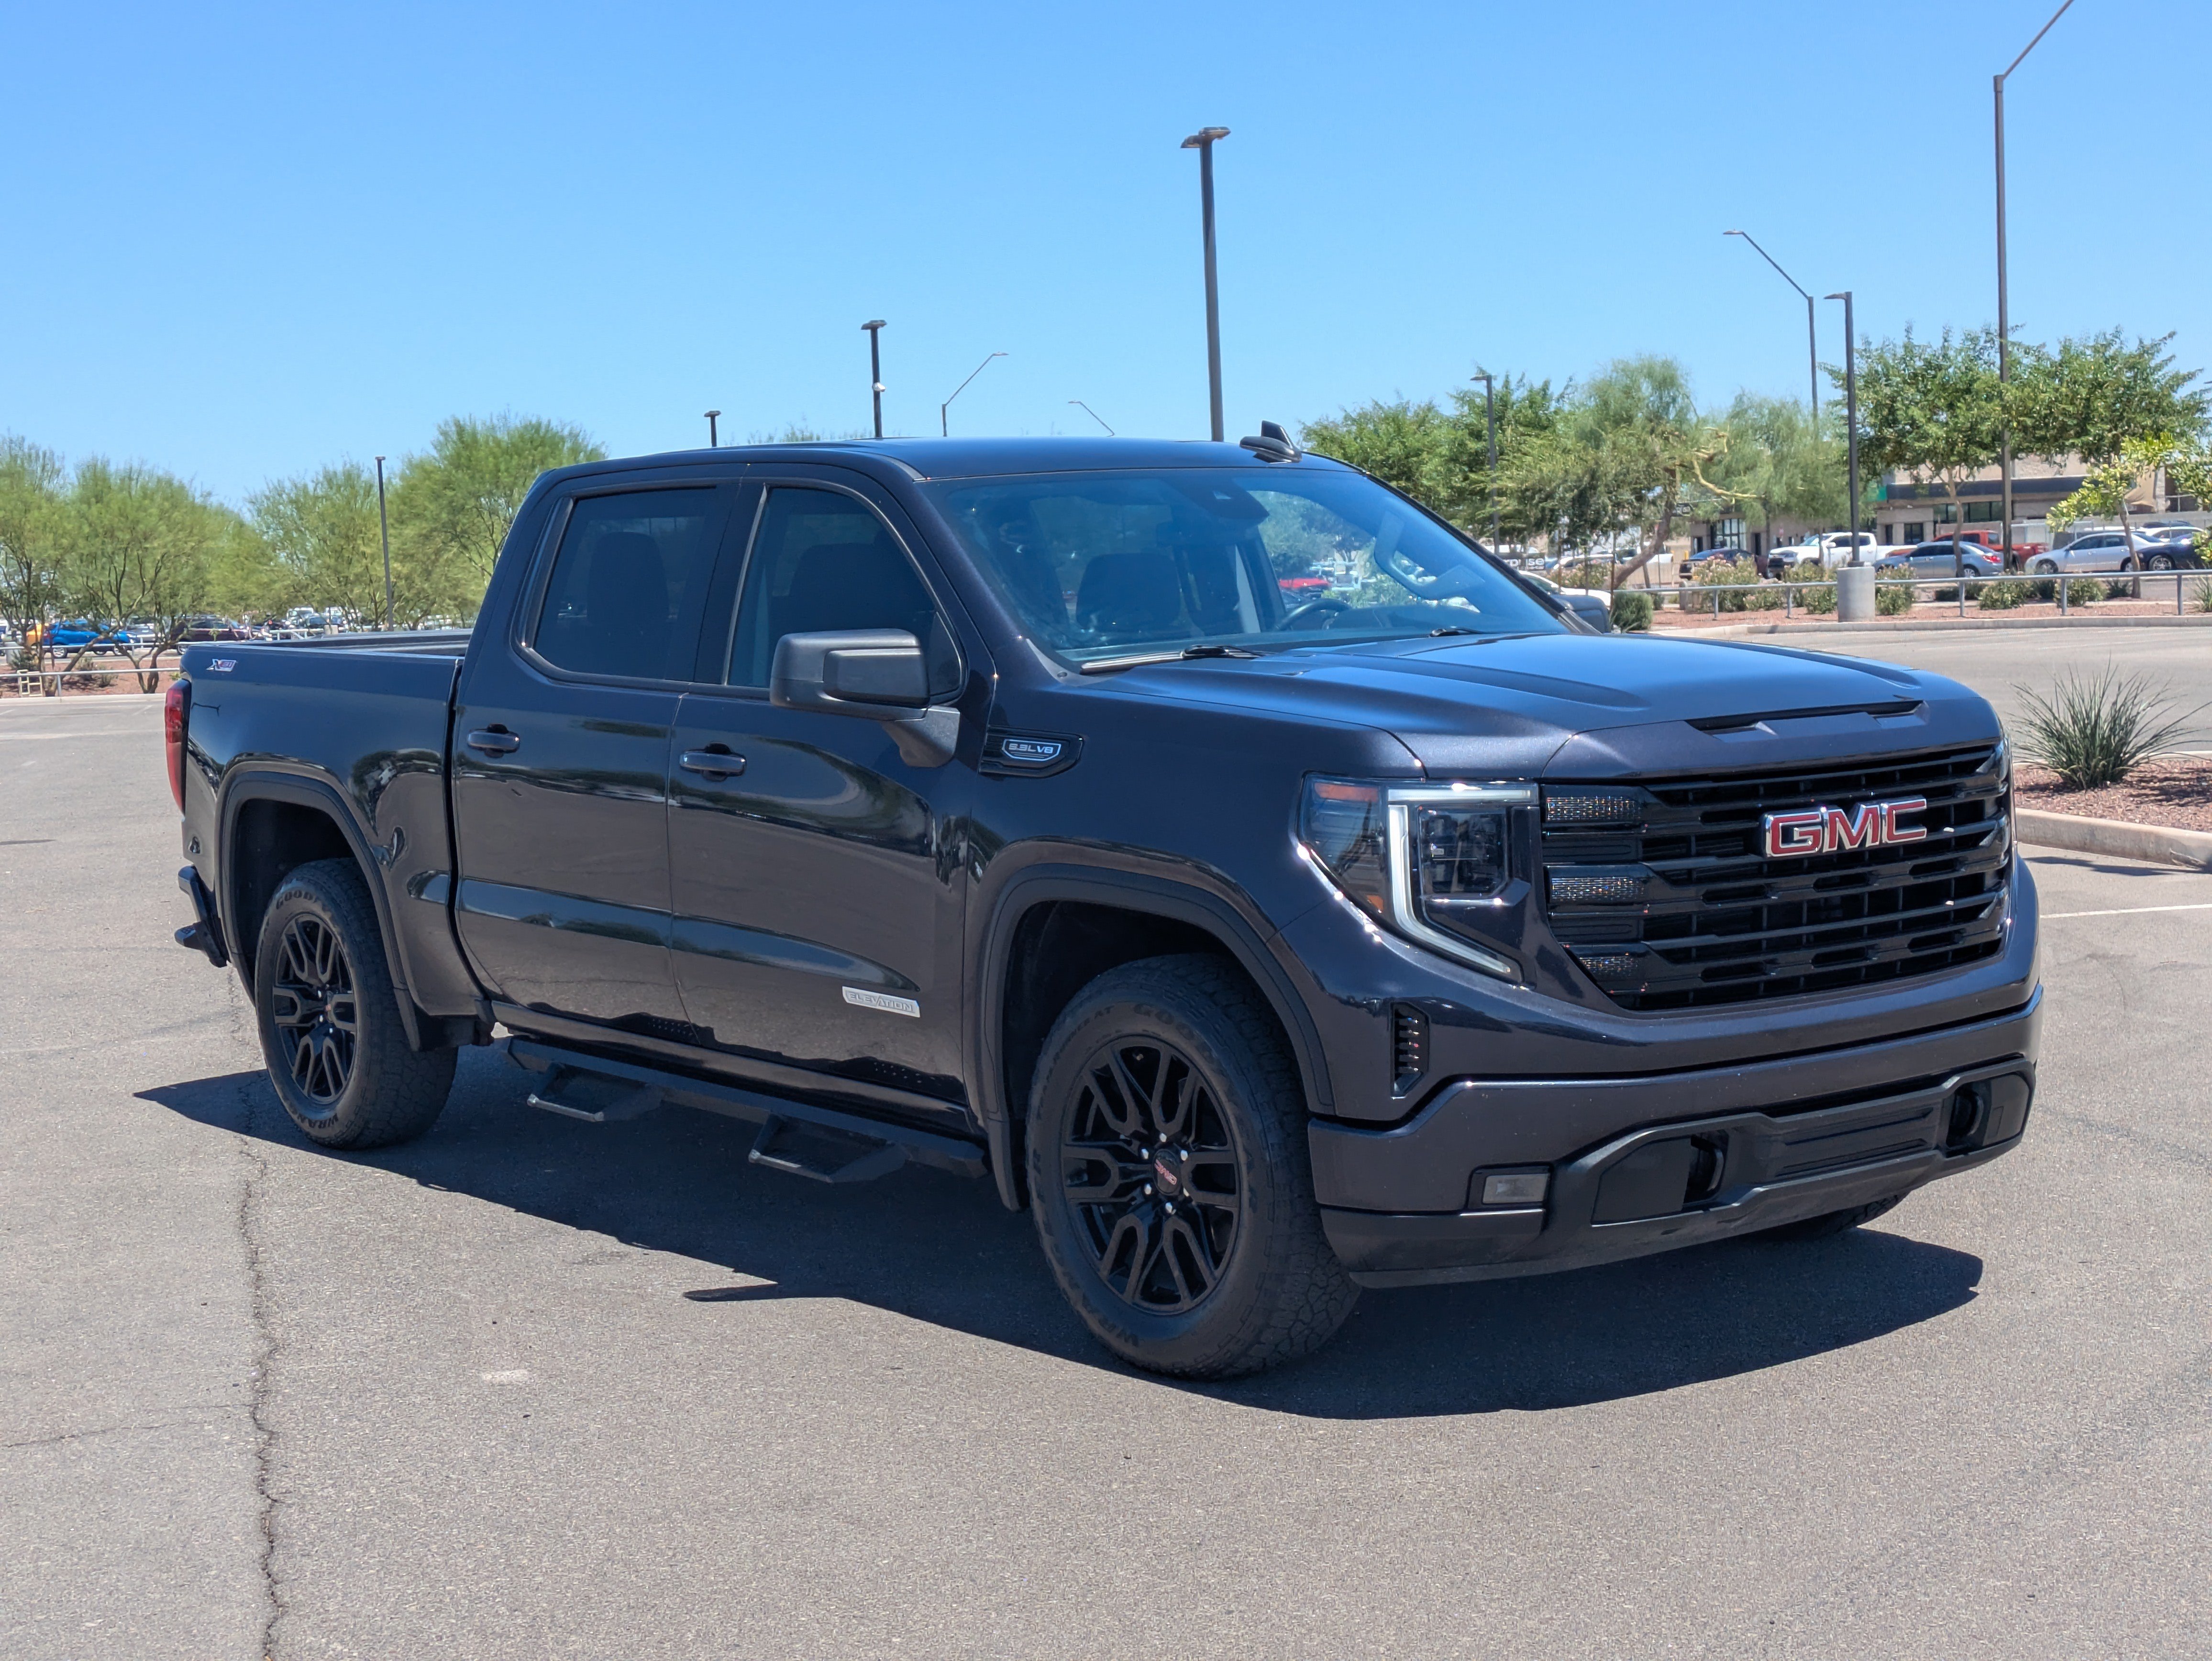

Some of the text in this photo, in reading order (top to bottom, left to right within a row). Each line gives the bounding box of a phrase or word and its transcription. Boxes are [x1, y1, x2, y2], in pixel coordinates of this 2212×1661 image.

[1762, 795, 1927, 857] GMC
[848, 993, 914, 1012] ELEVATION
[1154, 1159, 1177, 1185] GMC
